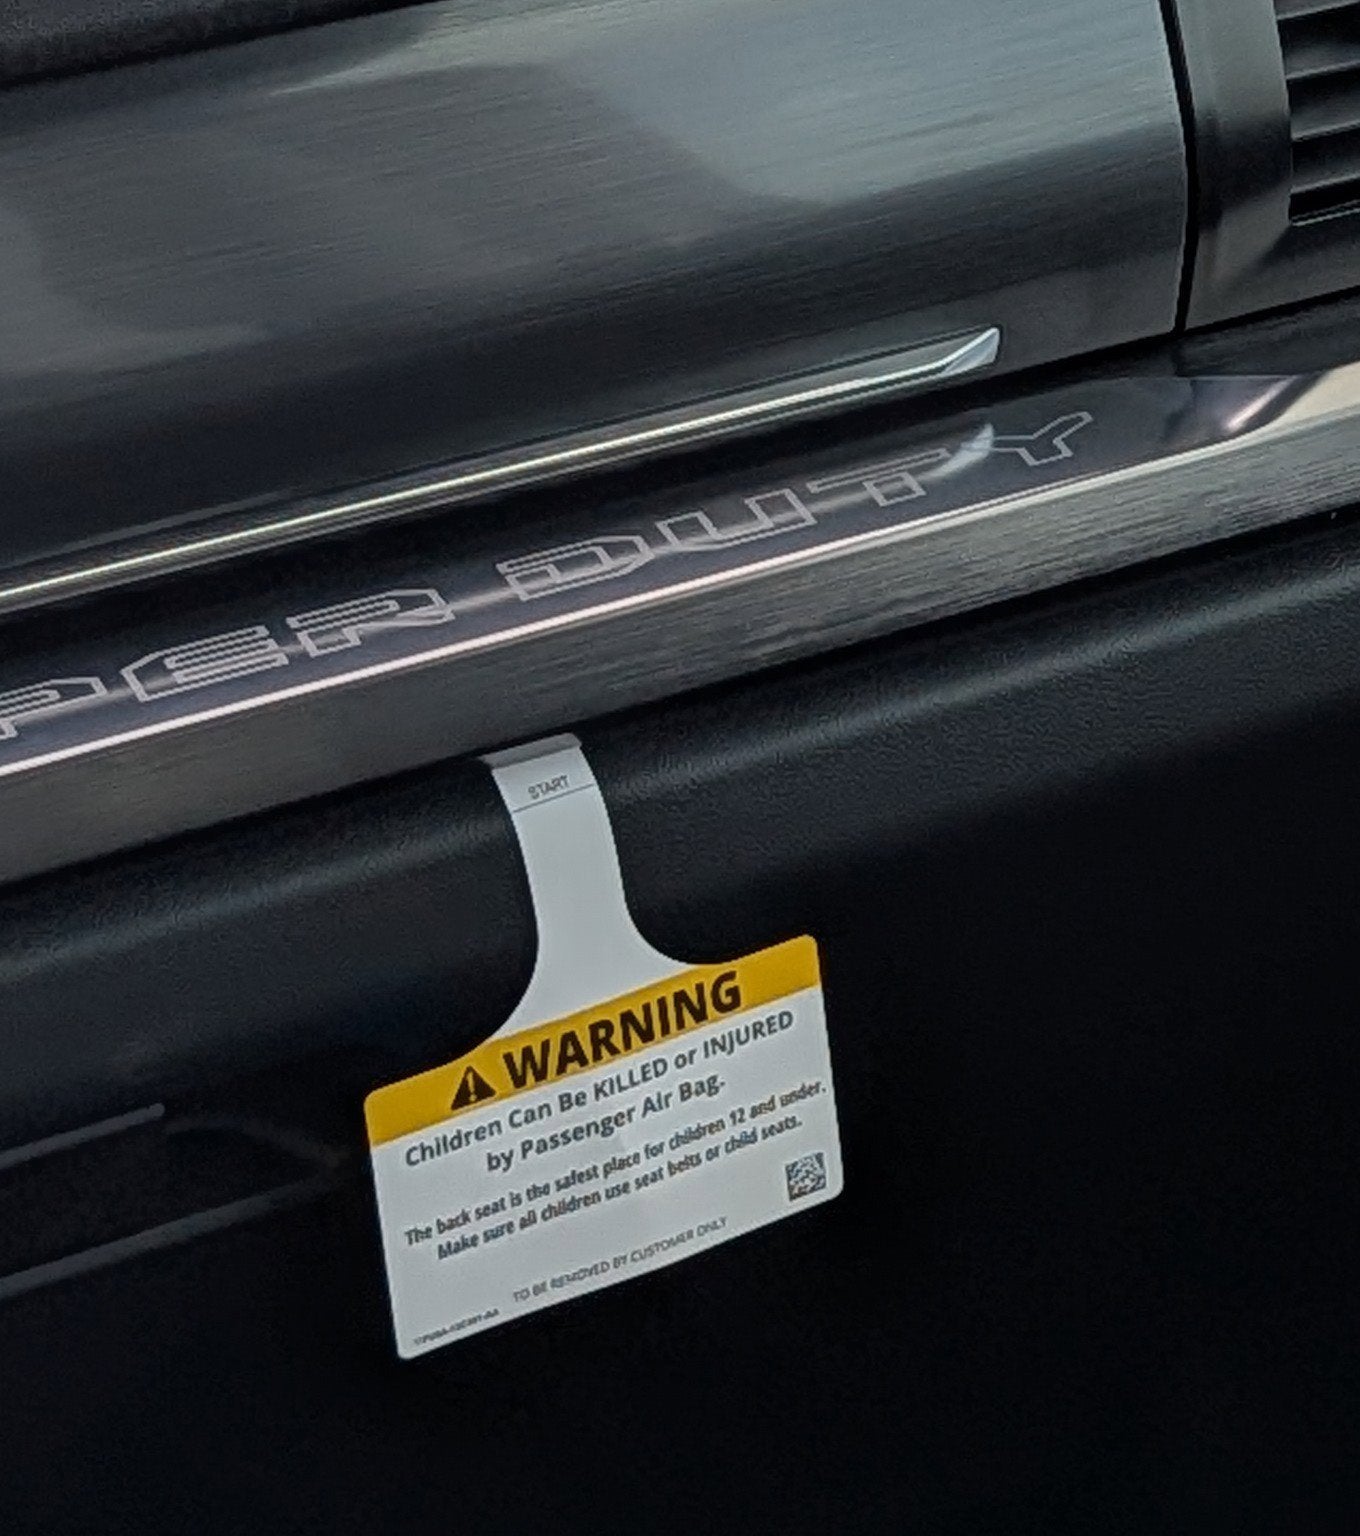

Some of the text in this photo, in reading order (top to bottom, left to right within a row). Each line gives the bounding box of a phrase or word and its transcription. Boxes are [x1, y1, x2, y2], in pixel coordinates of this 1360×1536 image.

[495, 411, 1093, 602] DUTY
[528, 775, 569, 800] START
[405, 1010, 794, 1167] Children Can Be KILLED or INJURED
[502, 970, 742, 1090] WARNING
[486, 1074, 726, 1173] by Passenger Air Bag.
